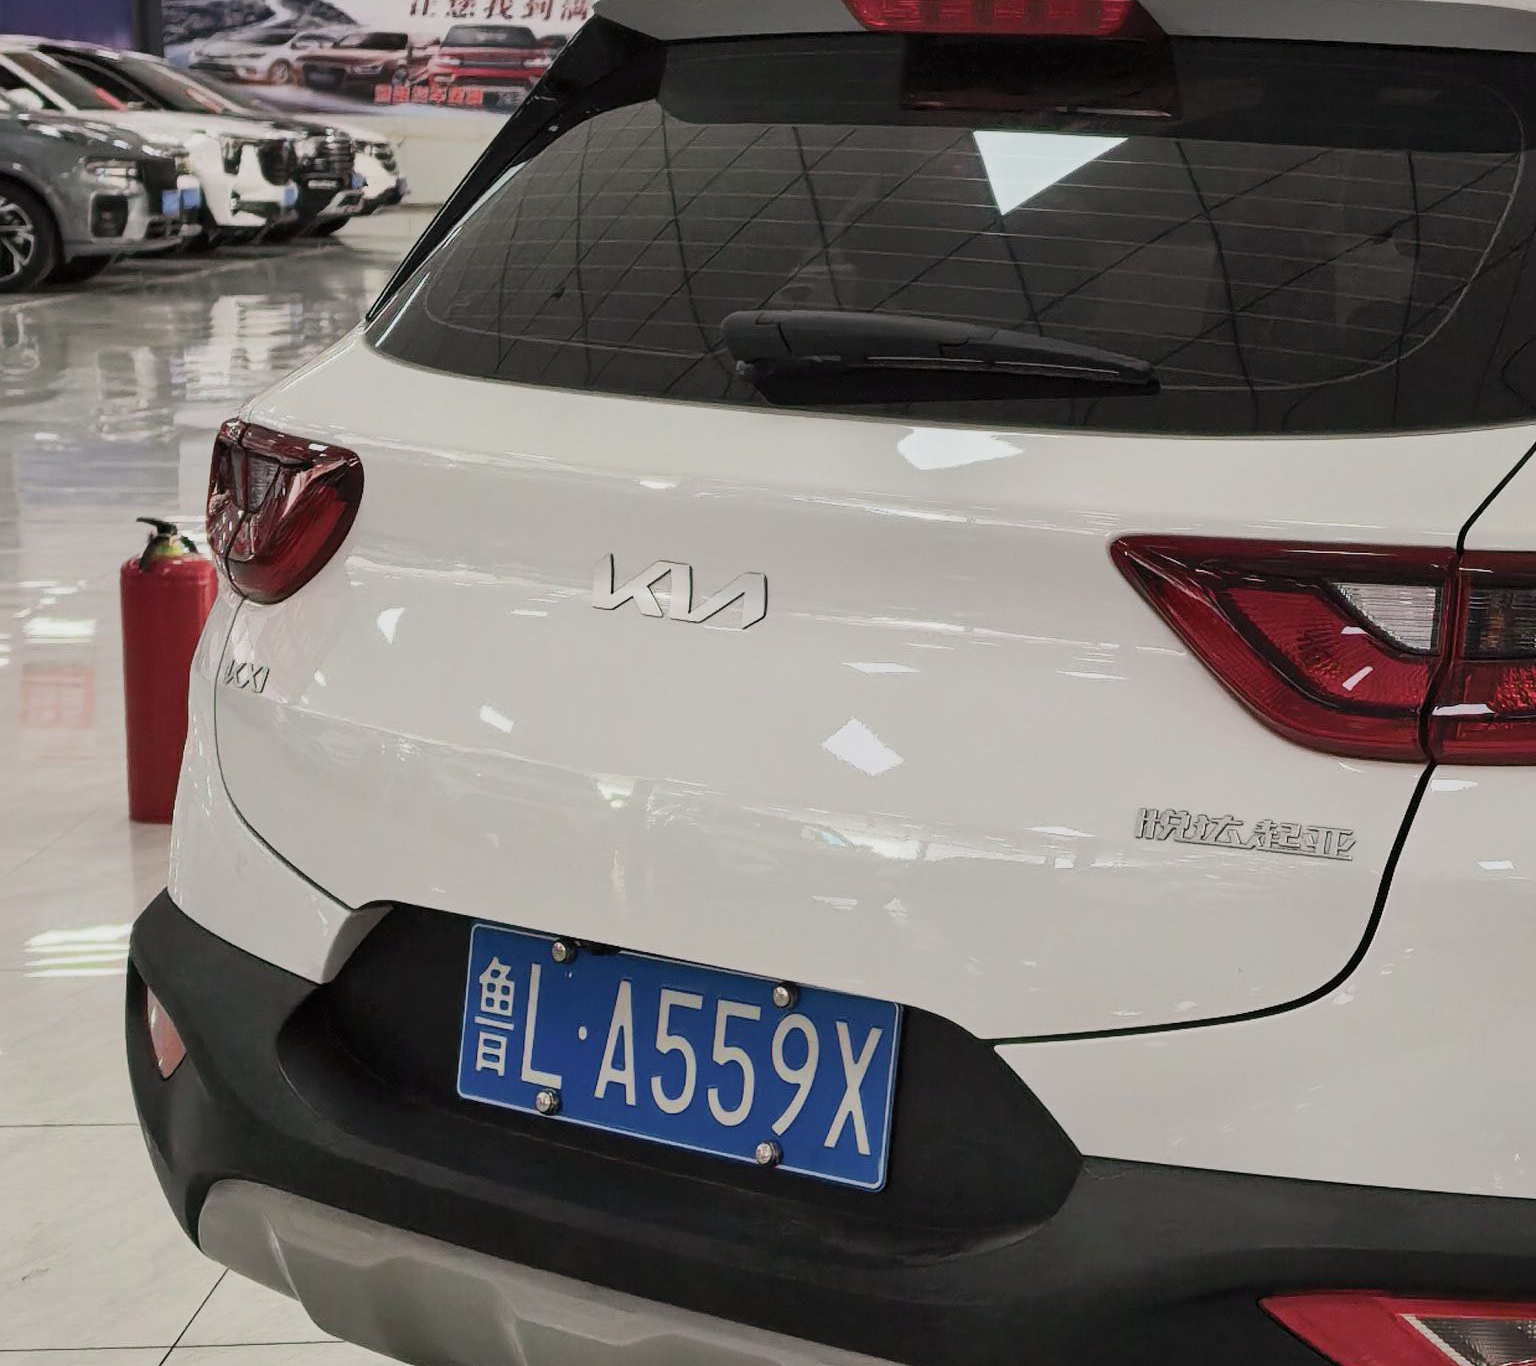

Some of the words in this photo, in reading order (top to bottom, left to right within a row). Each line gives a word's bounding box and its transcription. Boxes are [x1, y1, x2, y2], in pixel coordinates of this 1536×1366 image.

[592, 553, 768, 630] KIA
[1135, 807, 1358, 861] 悦达起亚
